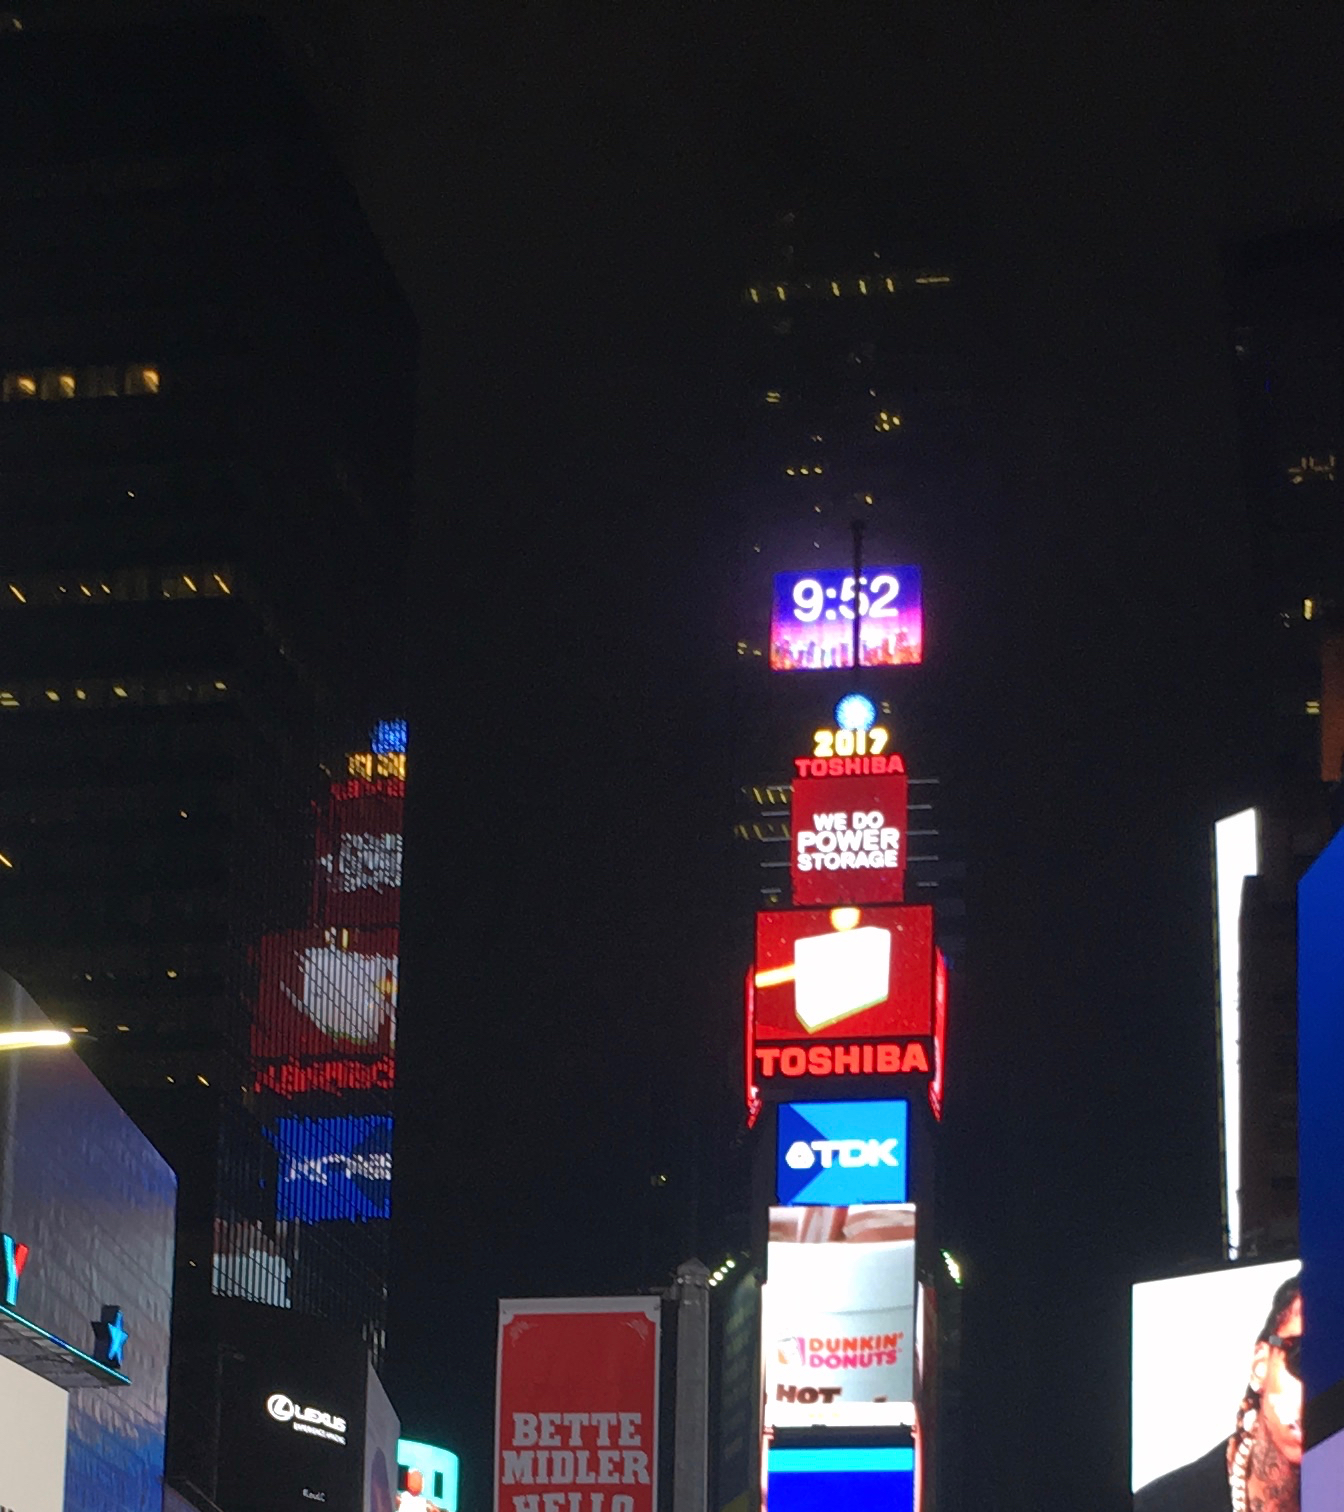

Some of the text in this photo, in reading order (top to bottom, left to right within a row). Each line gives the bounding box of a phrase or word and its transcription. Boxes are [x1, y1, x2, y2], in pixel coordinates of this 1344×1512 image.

[792, 574, 901, 622] 9:52
[812, 728, 889, 757] 2017
[795, 754, 905, 777] TOSHIBA
[812, 811, 885, 833] WE DO
[797, 827, 901, 854] POWER
[796, 850, 899, 872] STORAGE
[755, 1043, 929, 1078] TOSHIBA
[812, 1138, 899, 1168] TDK
[808, 1332, 904, 1355] DUNKIN'
[809, 1348, 899, 1370] DONUTS
[775, 1383, 842, 1405] HOT
[294, 1404, 347, 1434] LEXUS
[512, 1412, 642, 1447] BETTE
[501, 1449, 652, 1485] MIDLER
